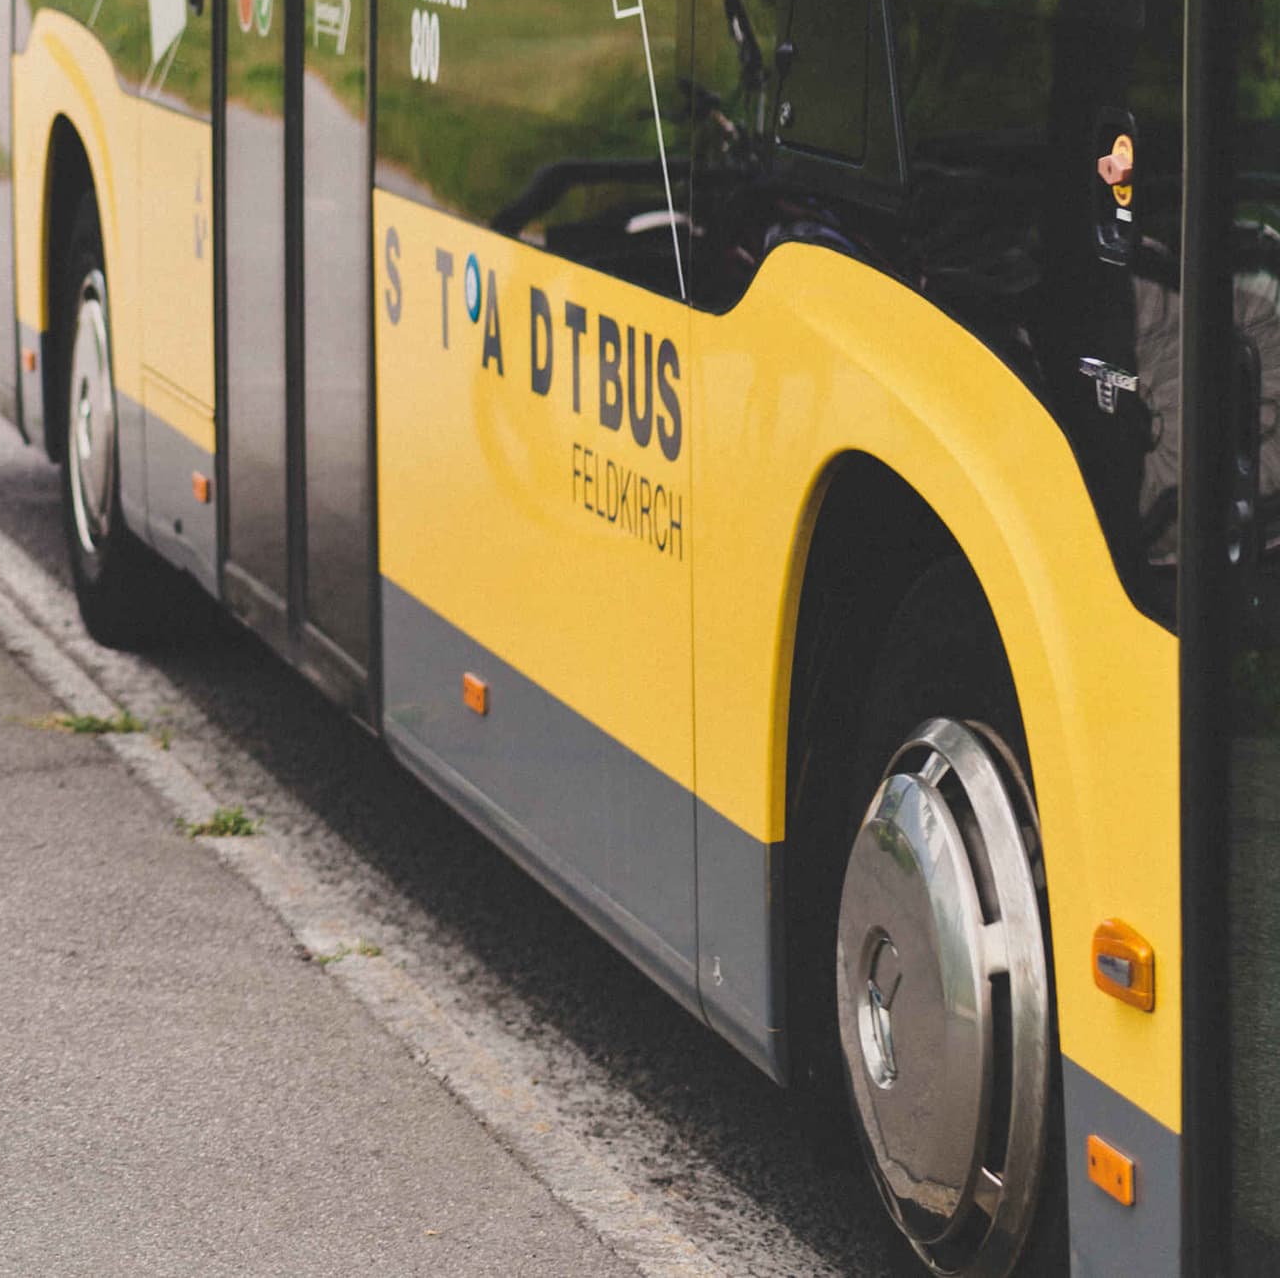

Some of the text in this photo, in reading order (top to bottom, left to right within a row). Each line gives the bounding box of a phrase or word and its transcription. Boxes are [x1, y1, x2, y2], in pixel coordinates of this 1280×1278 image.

[410, 9, 440, 84] 800
[384, 227, 683, 463] STADTBUS
[573, 442, 683, 560] FELDKIRCH
